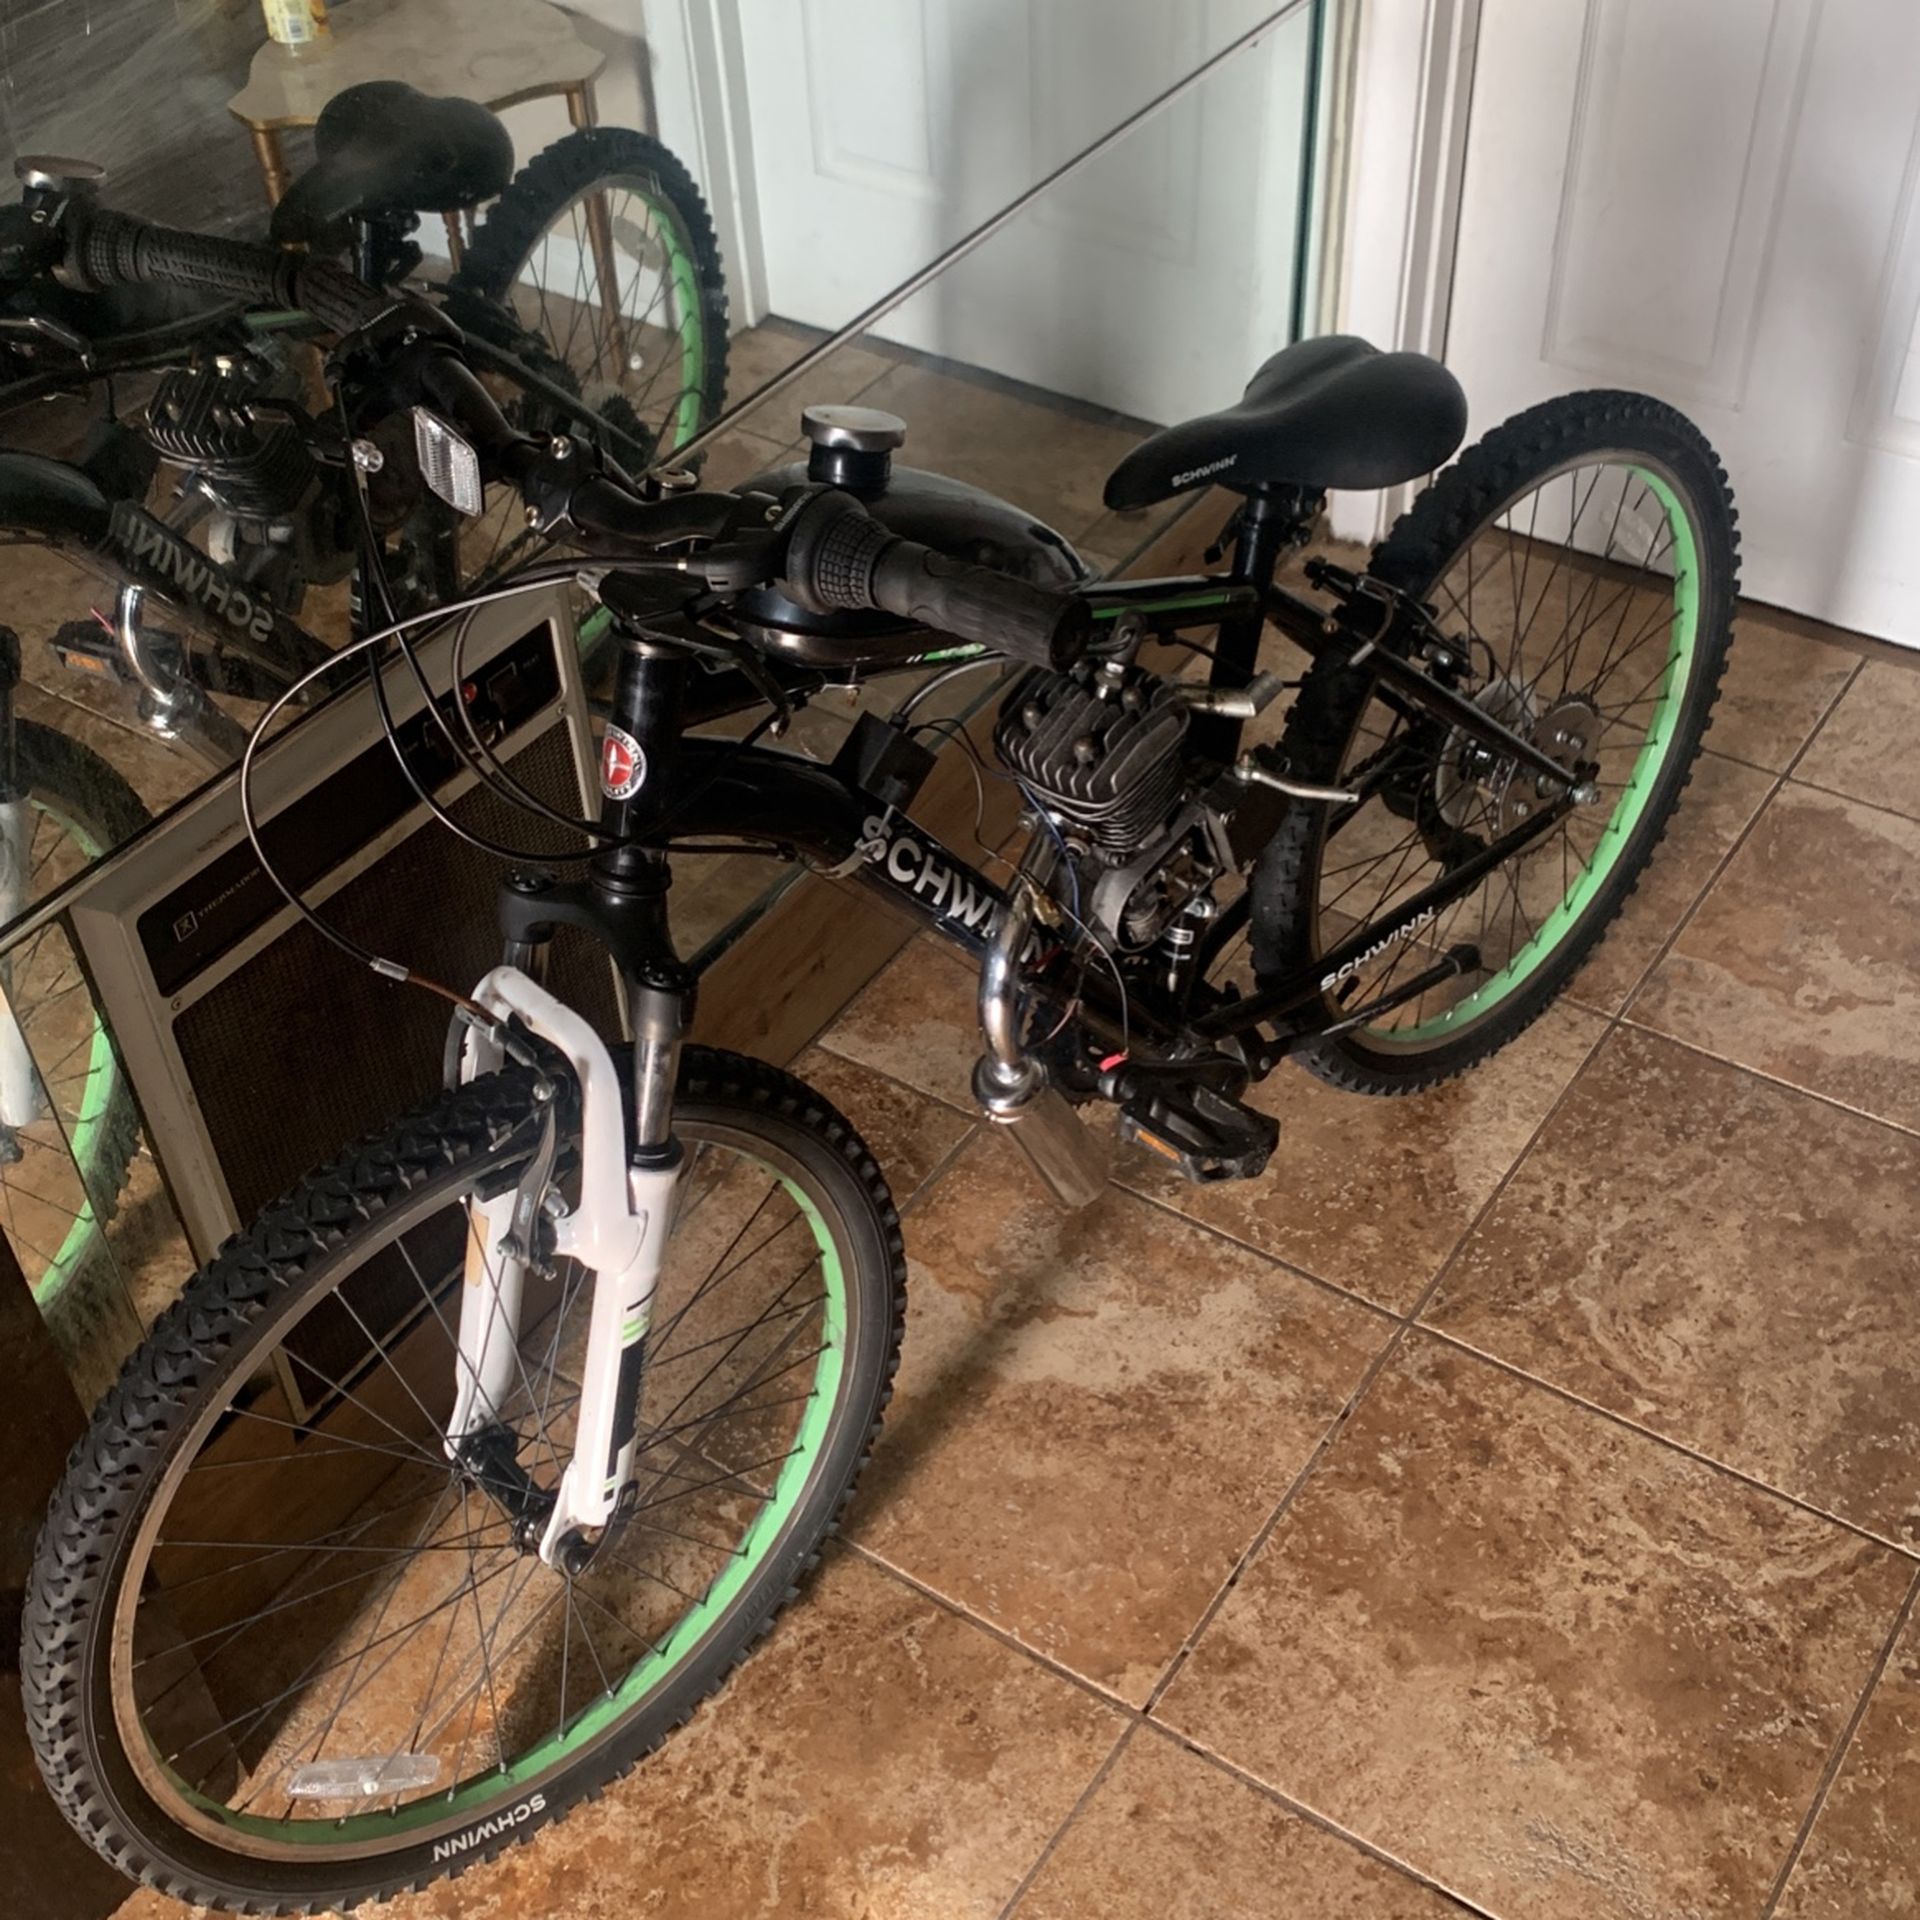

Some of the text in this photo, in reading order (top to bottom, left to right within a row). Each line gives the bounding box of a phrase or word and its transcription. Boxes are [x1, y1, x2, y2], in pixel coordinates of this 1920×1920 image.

[1171, 453, 1238, 488] SCHWINN
[1320, 905, 1436, 992] SCHWINN
[433, 1793, 547, 1863] SCHWINN
